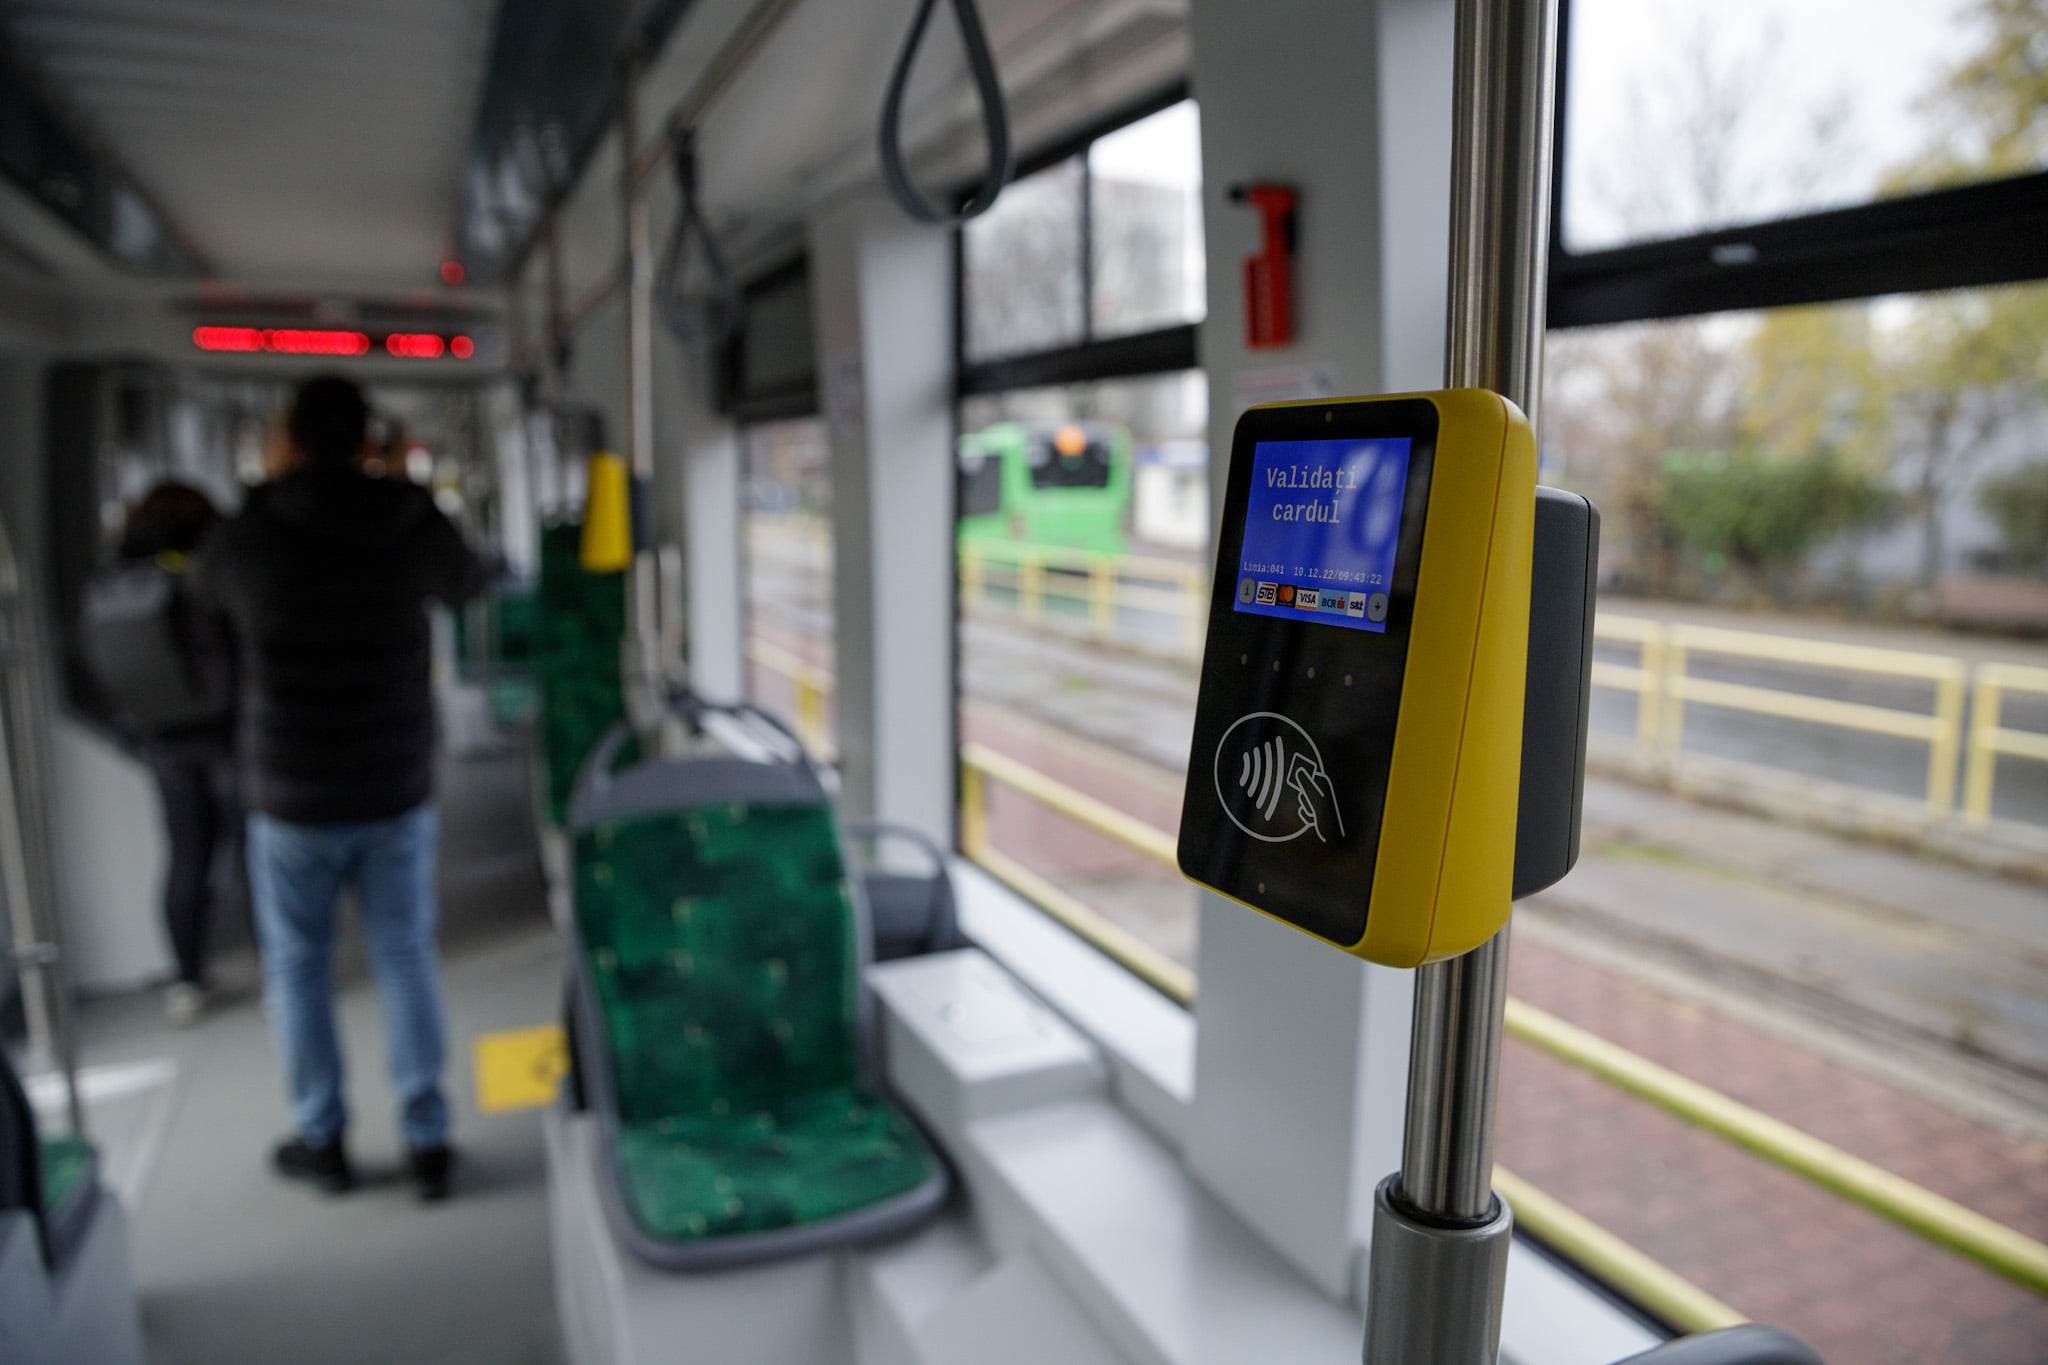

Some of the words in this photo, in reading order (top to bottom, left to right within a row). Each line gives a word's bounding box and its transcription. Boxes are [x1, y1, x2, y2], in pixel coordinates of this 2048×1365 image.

[1266, 465, 1357, 494] Validați
[1273, 499, 1341, 523] cardul
[1300, 592, 1316, 605] VISA
[1321, 598, 1337, 609] BCR
